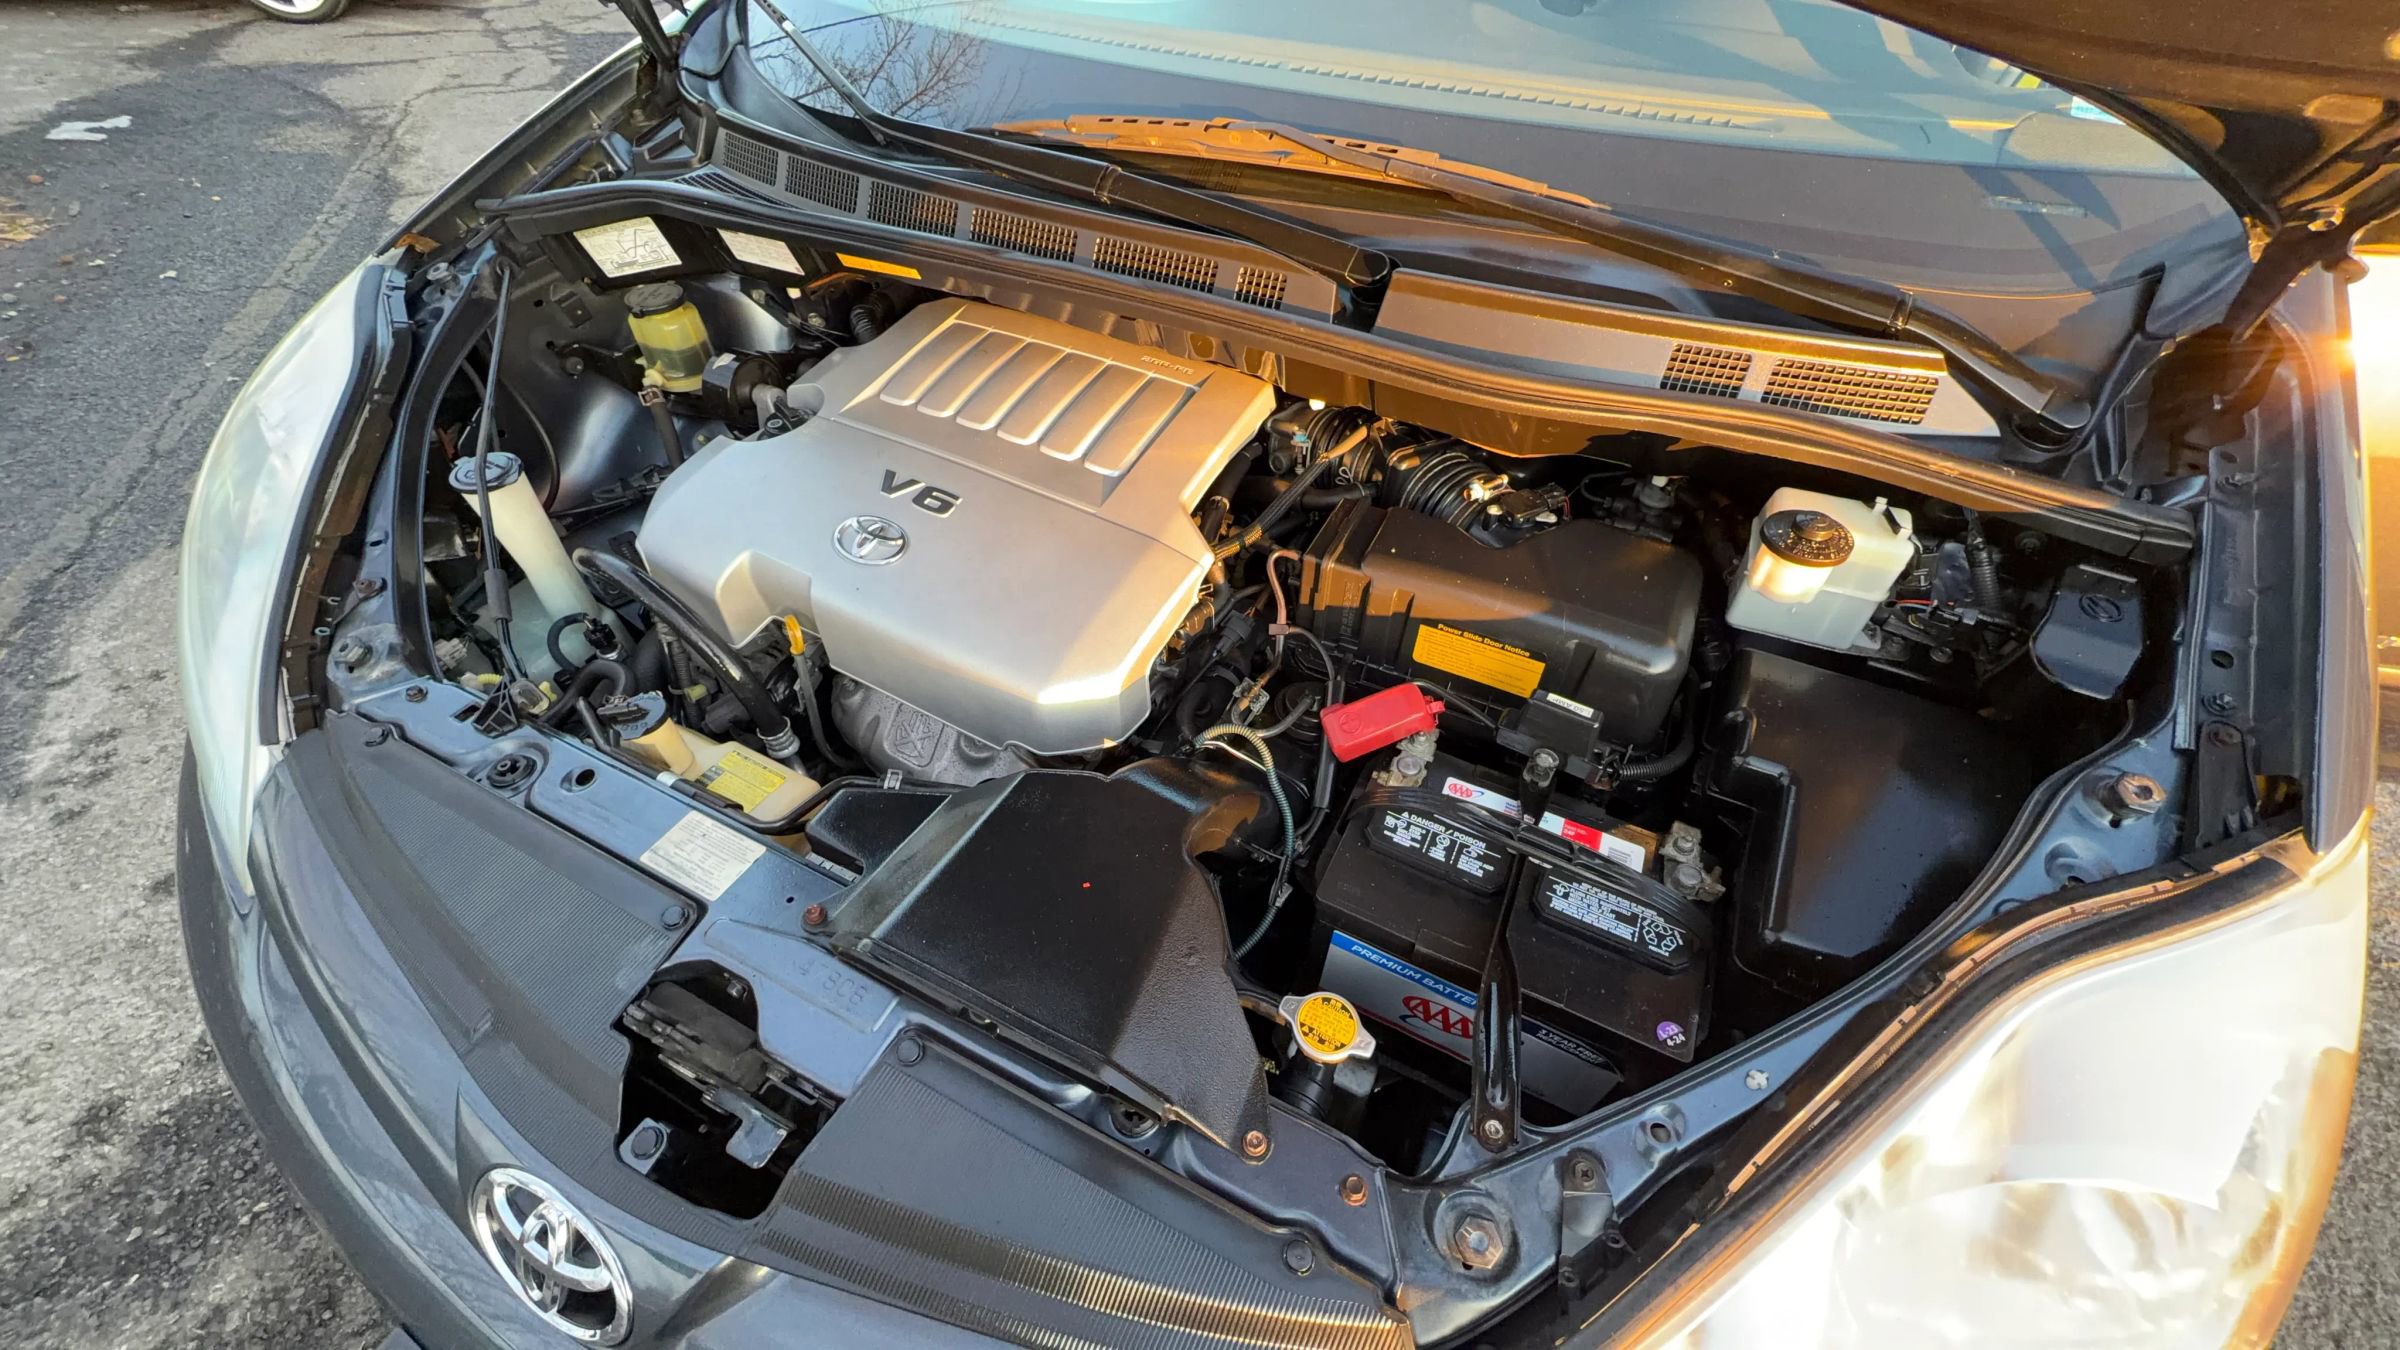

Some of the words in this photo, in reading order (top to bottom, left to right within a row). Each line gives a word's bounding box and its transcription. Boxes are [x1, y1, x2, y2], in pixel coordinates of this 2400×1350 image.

[881, 469, 962, 517] V6
[1437, 623, 1462, 636] Power
[1463, 631, 1483, 642] Slide
[1484, 638, 1504, 649] Door
[1504, 644, 1530, 658] Notice
[1448, 783, 1473, 799] AAA
[1410, 814, 1446, 834] DANGER
[1453, 832, 1486, 849] POISON
[1351, 944, 1421, 980] PREMIUM
[1404, 997, 1473, 1039] AAA
